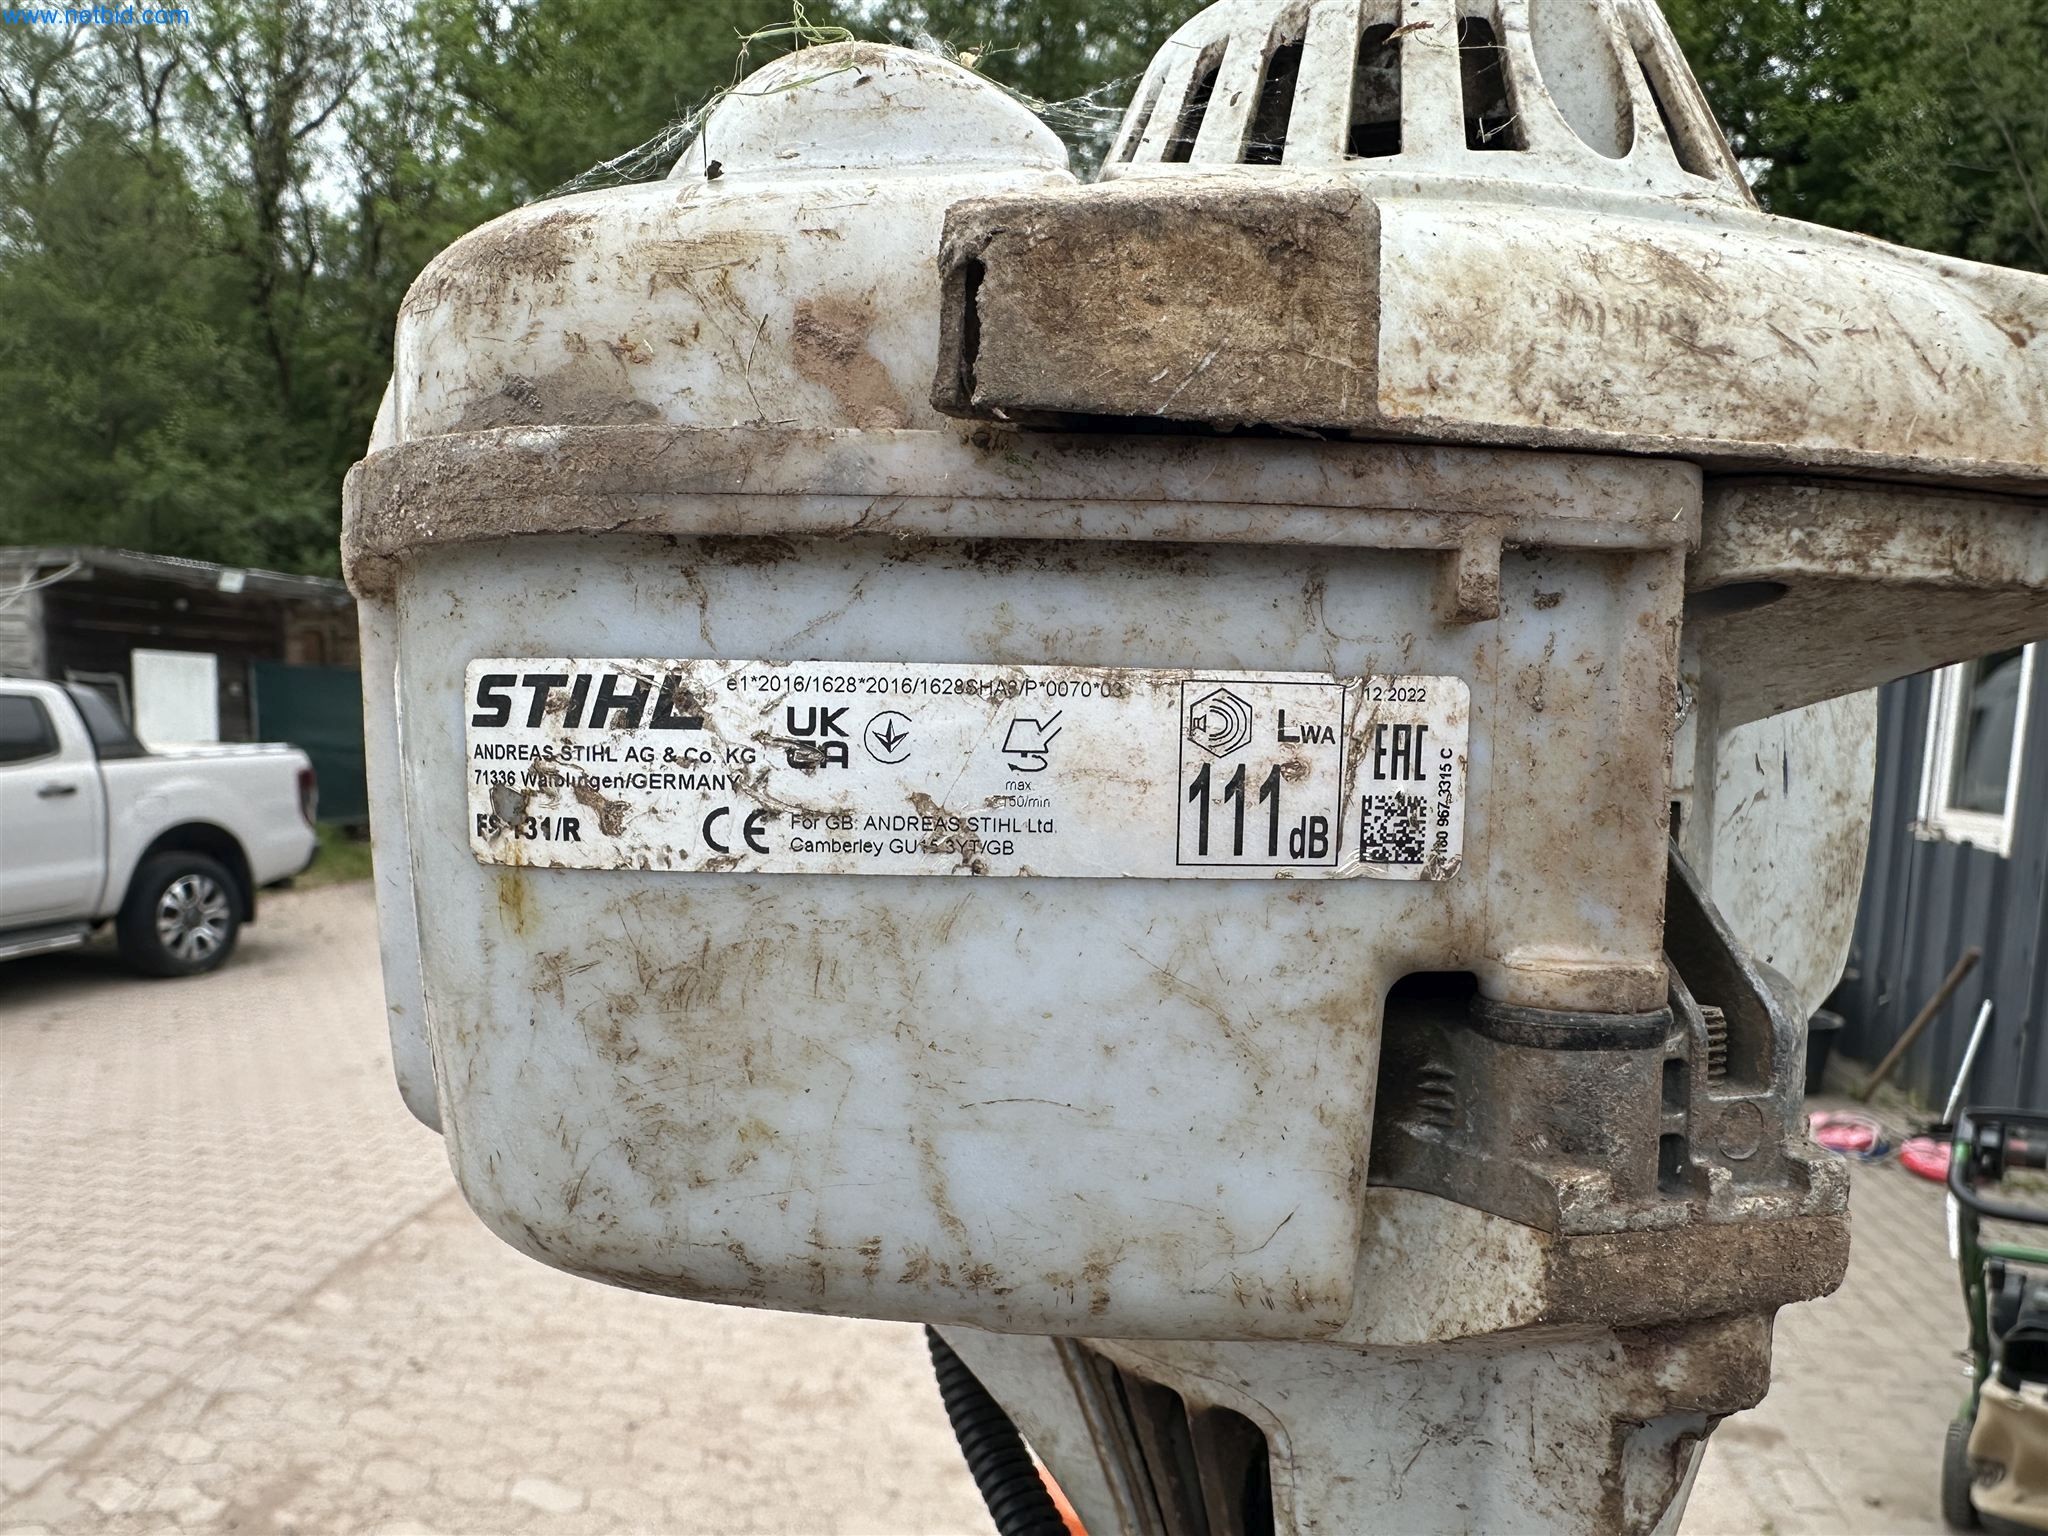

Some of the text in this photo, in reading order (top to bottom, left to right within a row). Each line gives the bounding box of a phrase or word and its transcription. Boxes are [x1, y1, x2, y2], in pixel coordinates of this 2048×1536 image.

[472, 673, 704, 730] STIHL
[787, 706, 850, 737] UK
[1277, 709, 1336, 745] LWA
[474, 743, 757, 765] ANDREAS STIHL AG & Co. KG
[1373, 723, 1429, 781] EAC
[1440, 748, 1453, 760] C
[474, 769, 516, 787] 71336
[1004, 780, 1036, 792] max.
[1438, 763, 1453, 797] 3315
[790, 813, 819, 831] For
[863, 815, 960, 833] ANDREAS
[968, 816, 1022, 834] STIHL
[1028, 817, 1059, 834] Ltd.
[1188, 762, 1282, 857] 111
[1436, 801, 1450, 826] 967
[702, 806, 770, 855] CE
[1289, 816, 1329, 860] dB
[789, 837, 882, 858] Camberley
